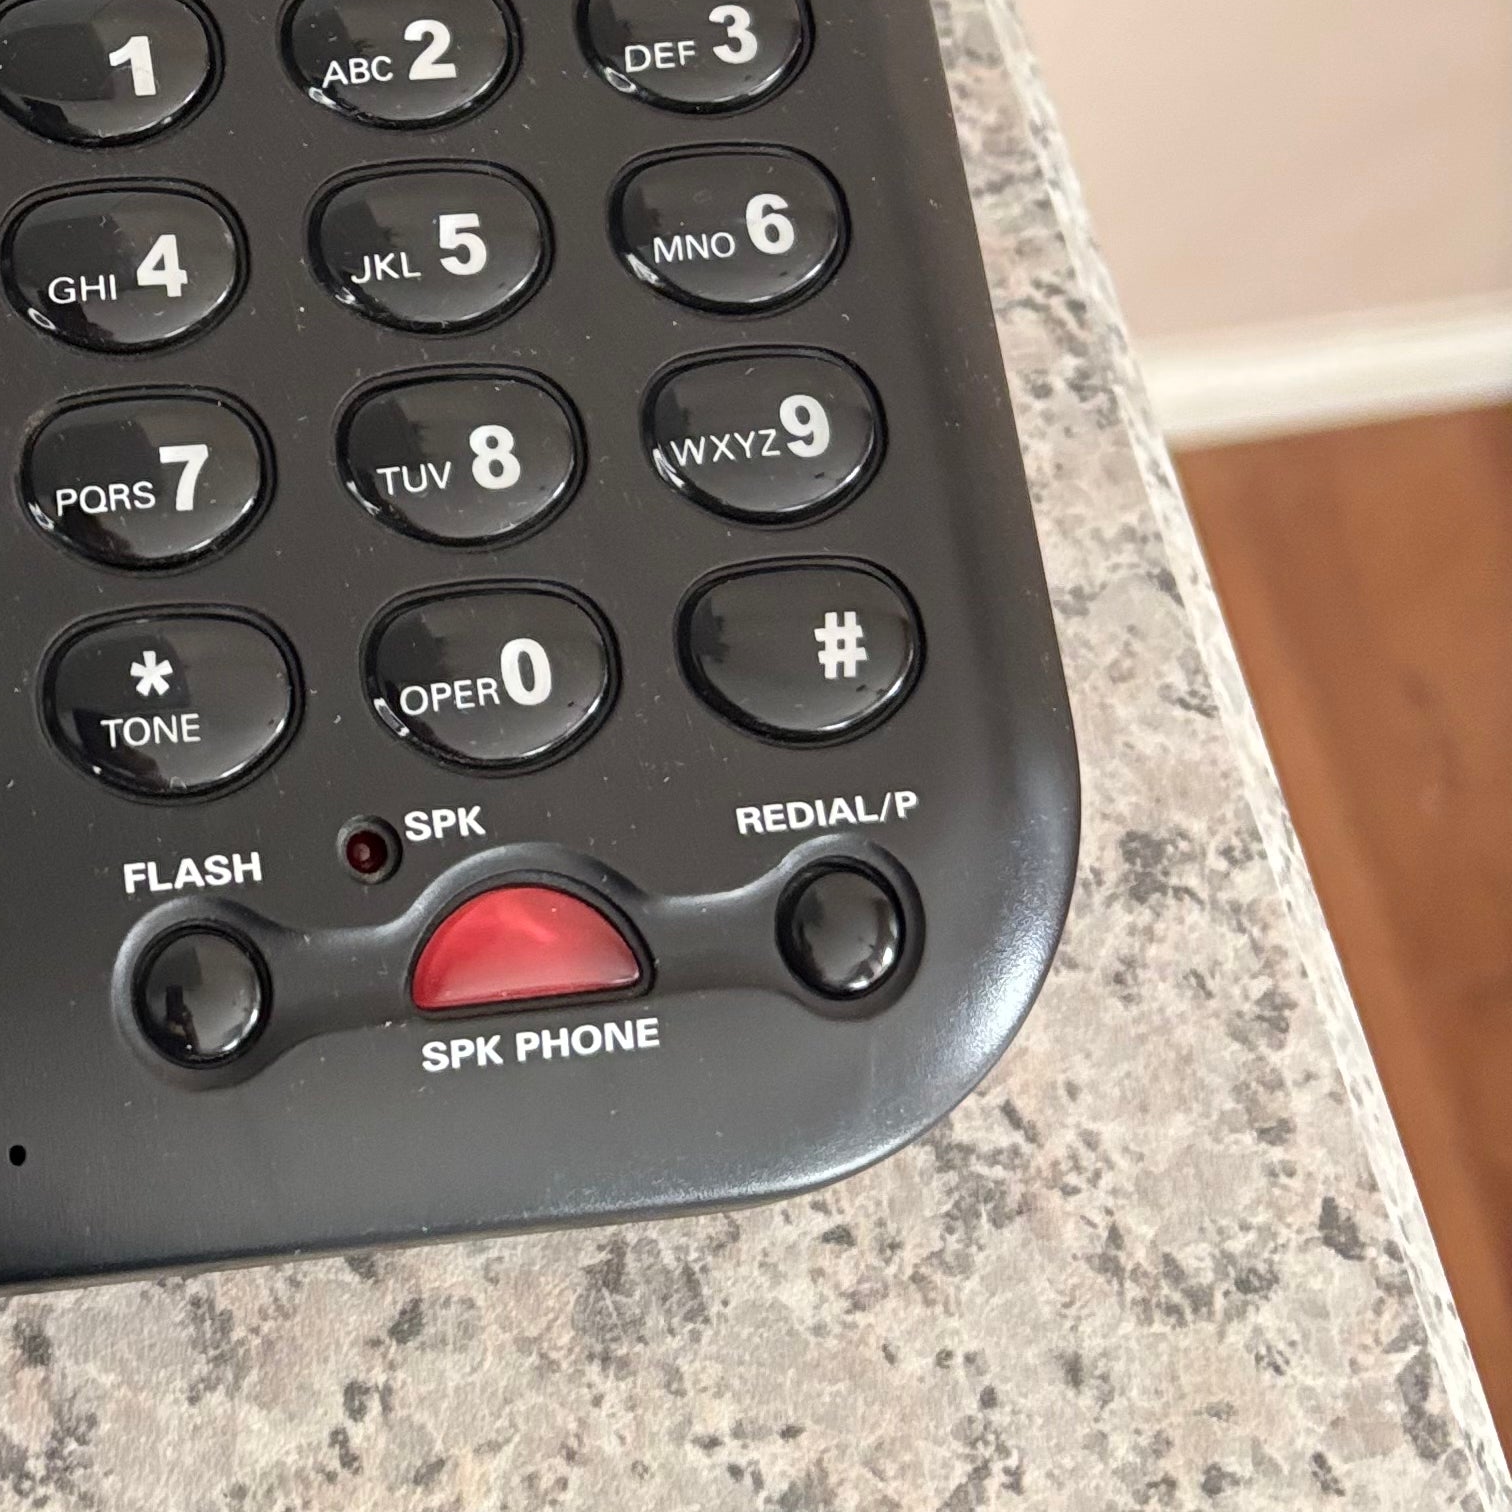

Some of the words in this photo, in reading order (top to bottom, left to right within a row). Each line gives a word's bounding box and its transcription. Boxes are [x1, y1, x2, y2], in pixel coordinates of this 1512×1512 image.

[108, 35, 157, 96] 1
[322, 55, 394, 87] ABC
[404, 19, 457, 81] 2
[624, 40, 696, 74] DEF
[708, 4, 758, 65] 3
[351, 251, 422, 284] JKL
[439, 213, 487, 276] 5
[653, 231, 736, 264] MNO
[745, 193, 795, 255] 6
[48, 274, 117, 304] GHI
[136, 234, 188, 298] 4
[376, 461, 452, 496] TUV
[469, 424, 521, 490] 8
[670, 428, 781, 465] WXYZ
[779, 394, 831, 458] 9
[56, 480, 156, 517] PQRS
[158, 443, 209, 512] 7
[399, 677, 499, 716] OPER
[500, 637, 552, 706] 0
[813, 611, 868, 680] #
[100, 713, 201, 748] TONE
[404, 805, 486, 842] SPK
[735, 790, 918, 835] REDIAL/P
[123, 851, 262, 894] FLASH
[421, 1034, 504, 1073] SPK
[515, 1017, 660, 1062] PHONE
